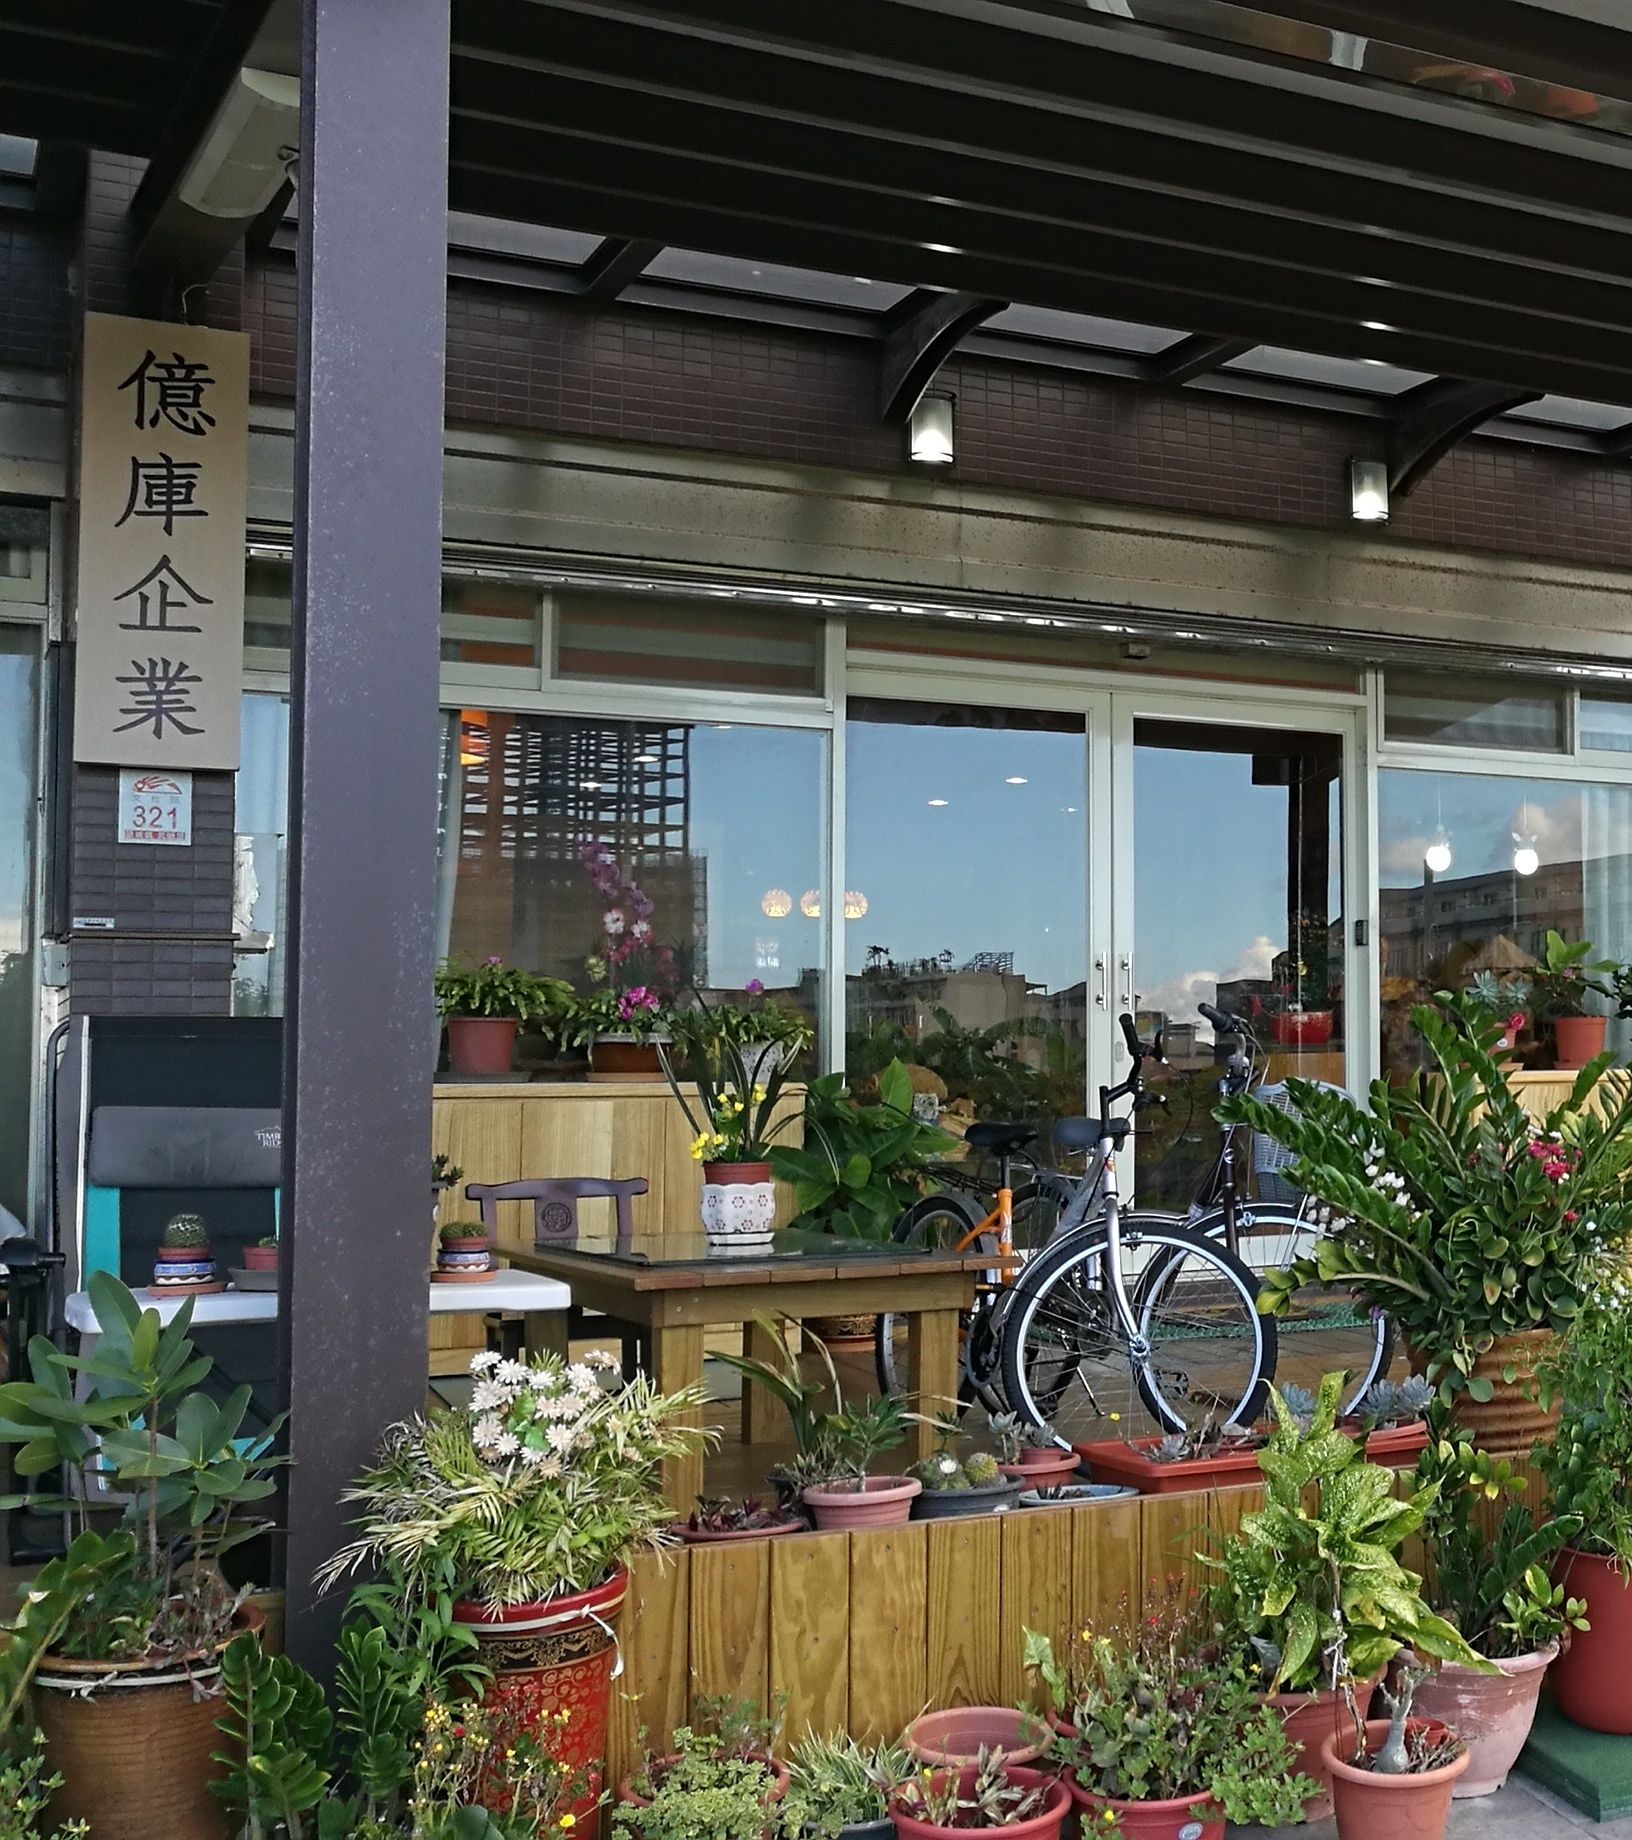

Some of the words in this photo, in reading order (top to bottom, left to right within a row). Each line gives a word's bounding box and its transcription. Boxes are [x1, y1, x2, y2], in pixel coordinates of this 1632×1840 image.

[113, 348, 216, 740] 億庫企業
[133, 805, 177, 829] 321
[256, 1132, 281, 1140] TIMB
